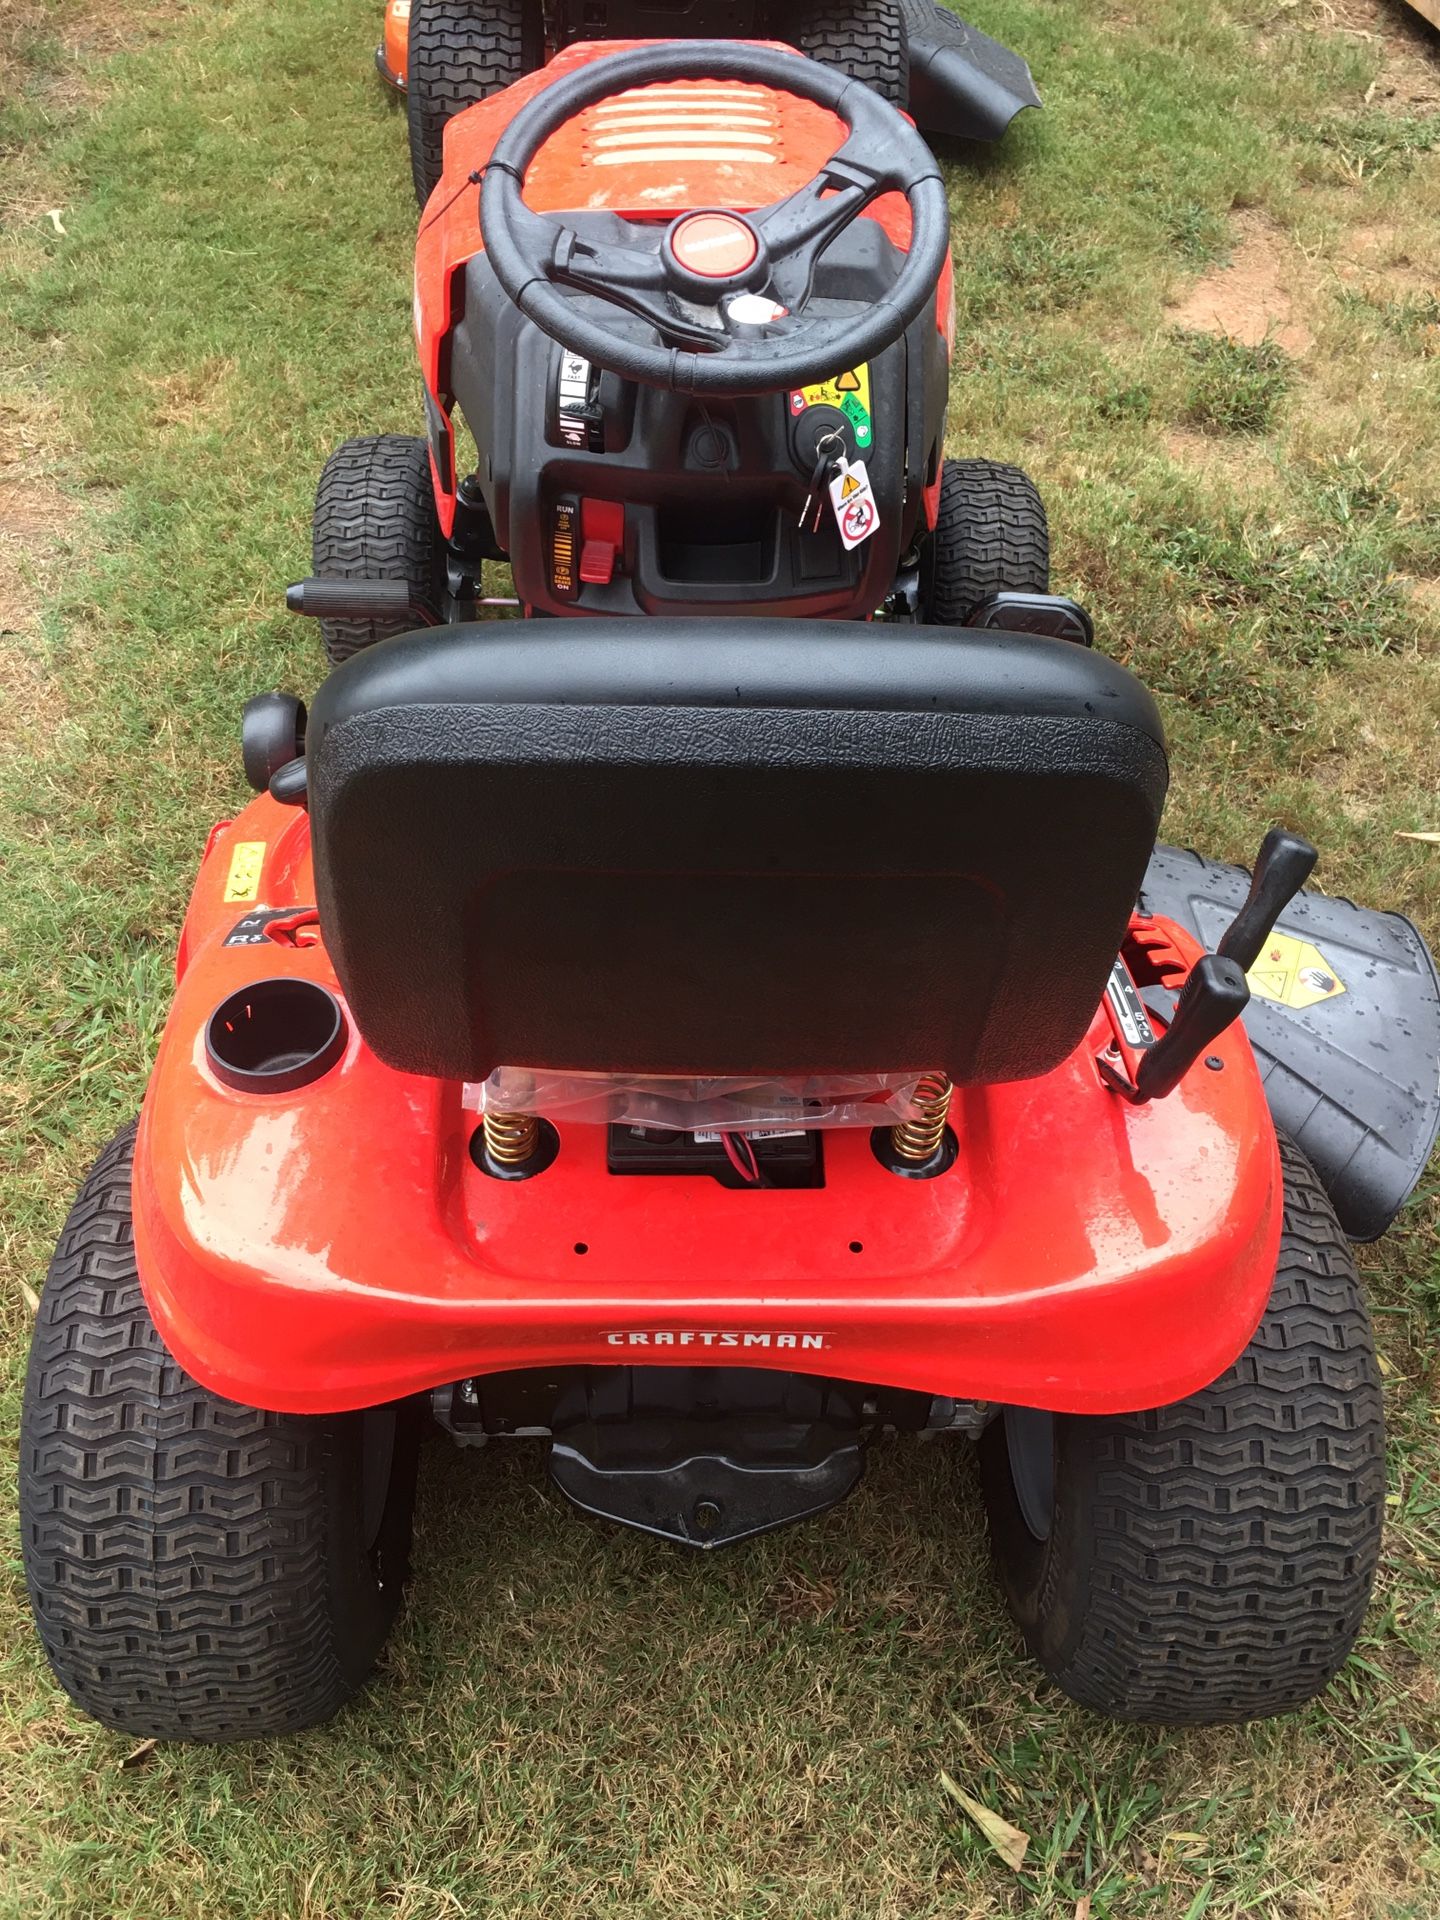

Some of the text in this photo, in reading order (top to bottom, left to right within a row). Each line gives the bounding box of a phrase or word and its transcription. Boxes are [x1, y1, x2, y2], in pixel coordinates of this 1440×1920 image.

[556, 504, 574, 514] RUN
[240, 919, 262, 927] N
[228, 934, 250, 944] R
[1124, 985, 1134, 994] 4
[1134, 1011, 1145, 1021] 5
[607, 1331, 824, 1349] CRAFTSMAN
